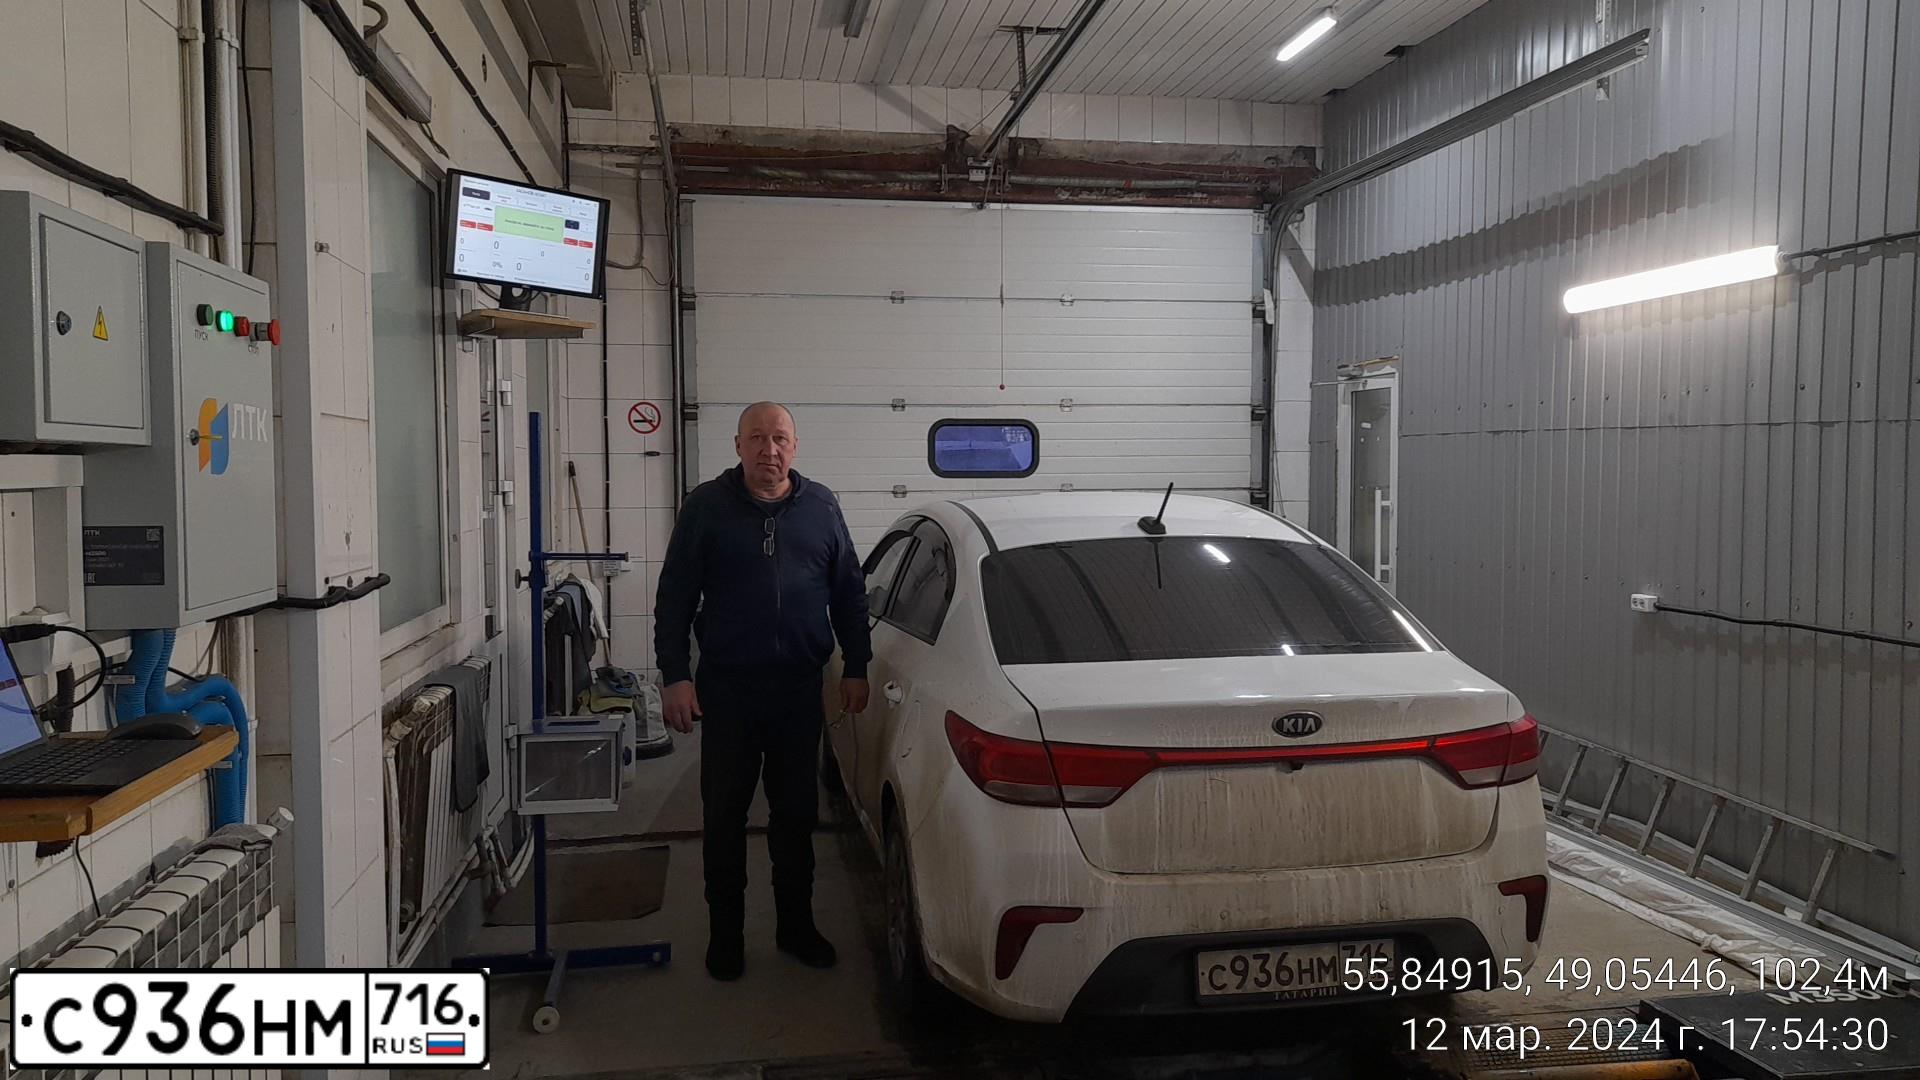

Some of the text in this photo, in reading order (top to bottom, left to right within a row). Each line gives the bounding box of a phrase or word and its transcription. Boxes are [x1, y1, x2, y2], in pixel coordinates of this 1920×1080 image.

[494, 241, 499, 250] 0
[459, 253, 465, 262] 0
[194, 329, 209, 342] ПУСК
[231, 403, 268, 442] ЛТК
[1282, 717, 1317, 733] KIA
[1207, 951, 1338, 991] С936НМ
